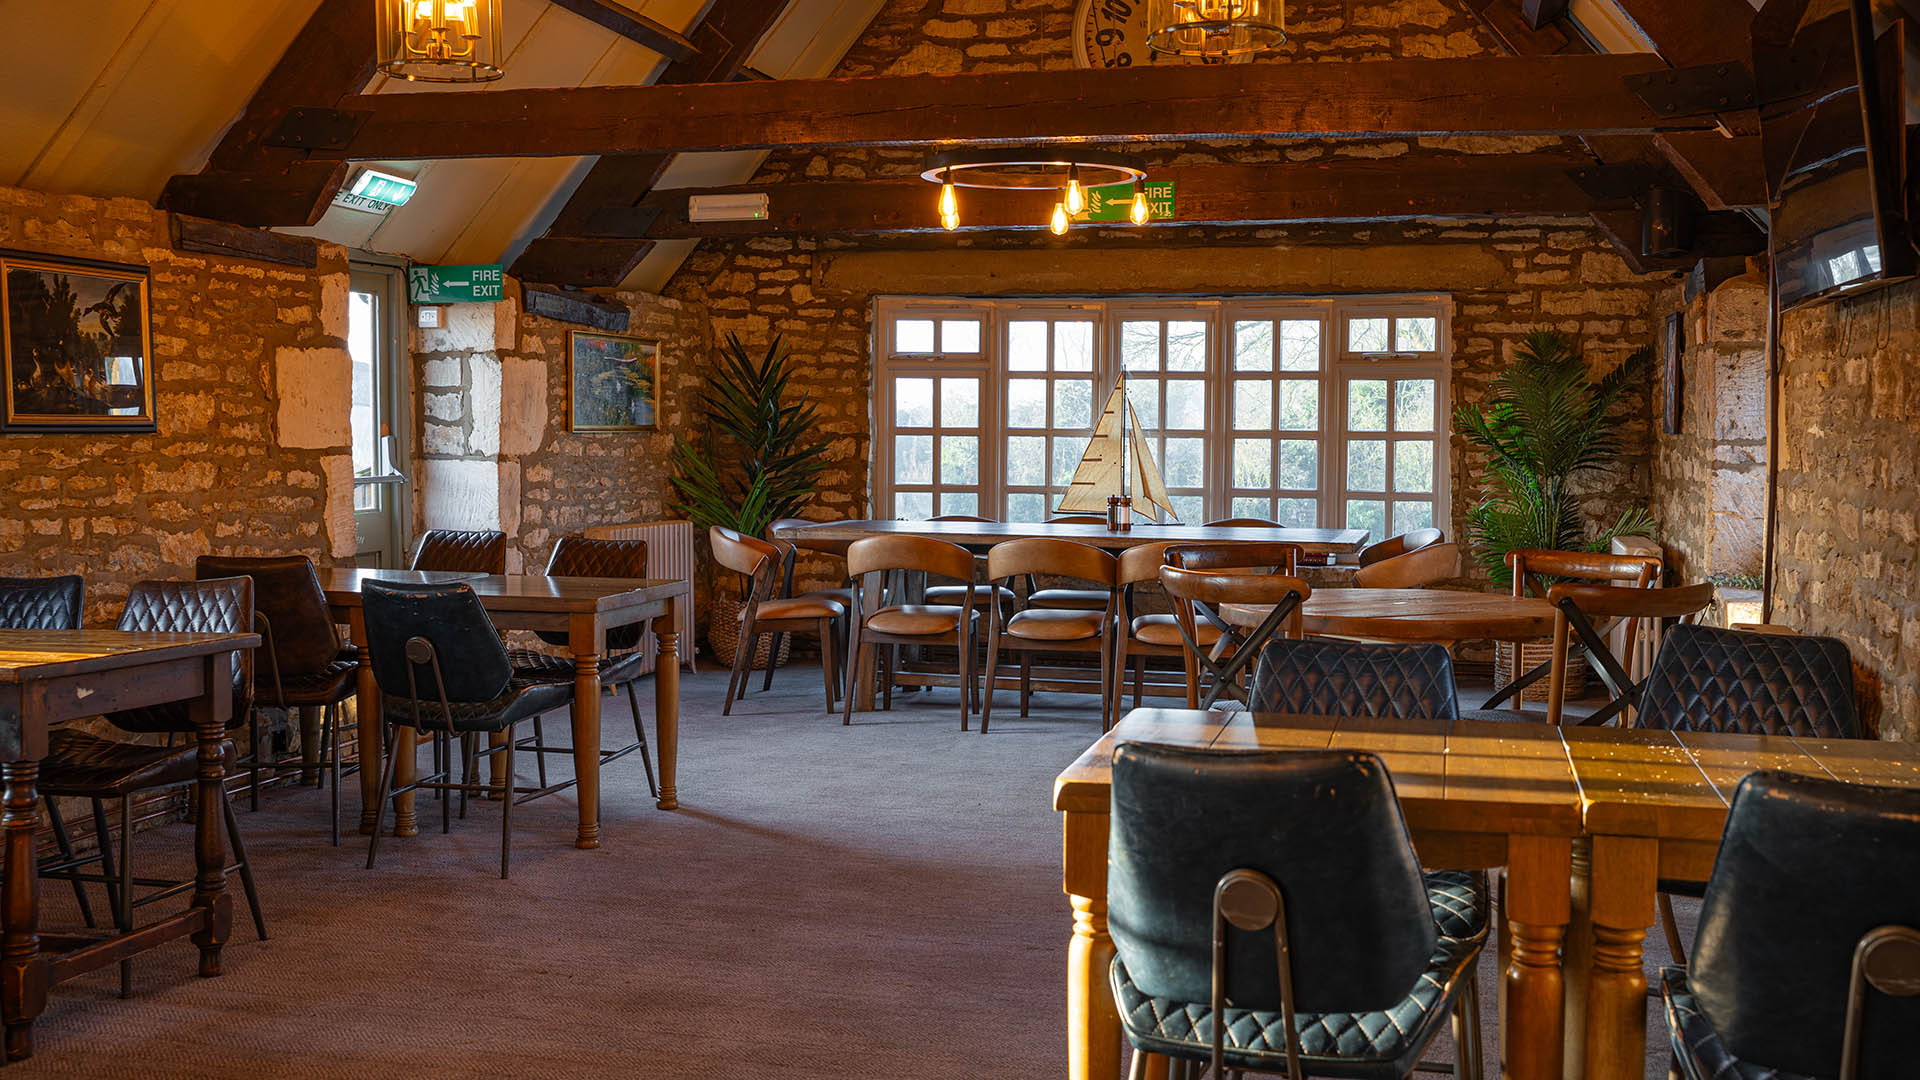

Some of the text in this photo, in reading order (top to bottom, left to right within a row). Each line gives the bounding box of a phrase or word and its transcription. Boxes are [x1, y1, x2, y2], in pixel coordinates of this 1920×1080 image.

[1101, 0, 1132, 24] 10
[342, 193, 367, 206] EXIT
[367, 199, 389, 211] ONLY
[1148, 202, 1172, 215] XIT
[472, 270, 500, 281] FIRE
[472, 285, 500, 297] EXIT
